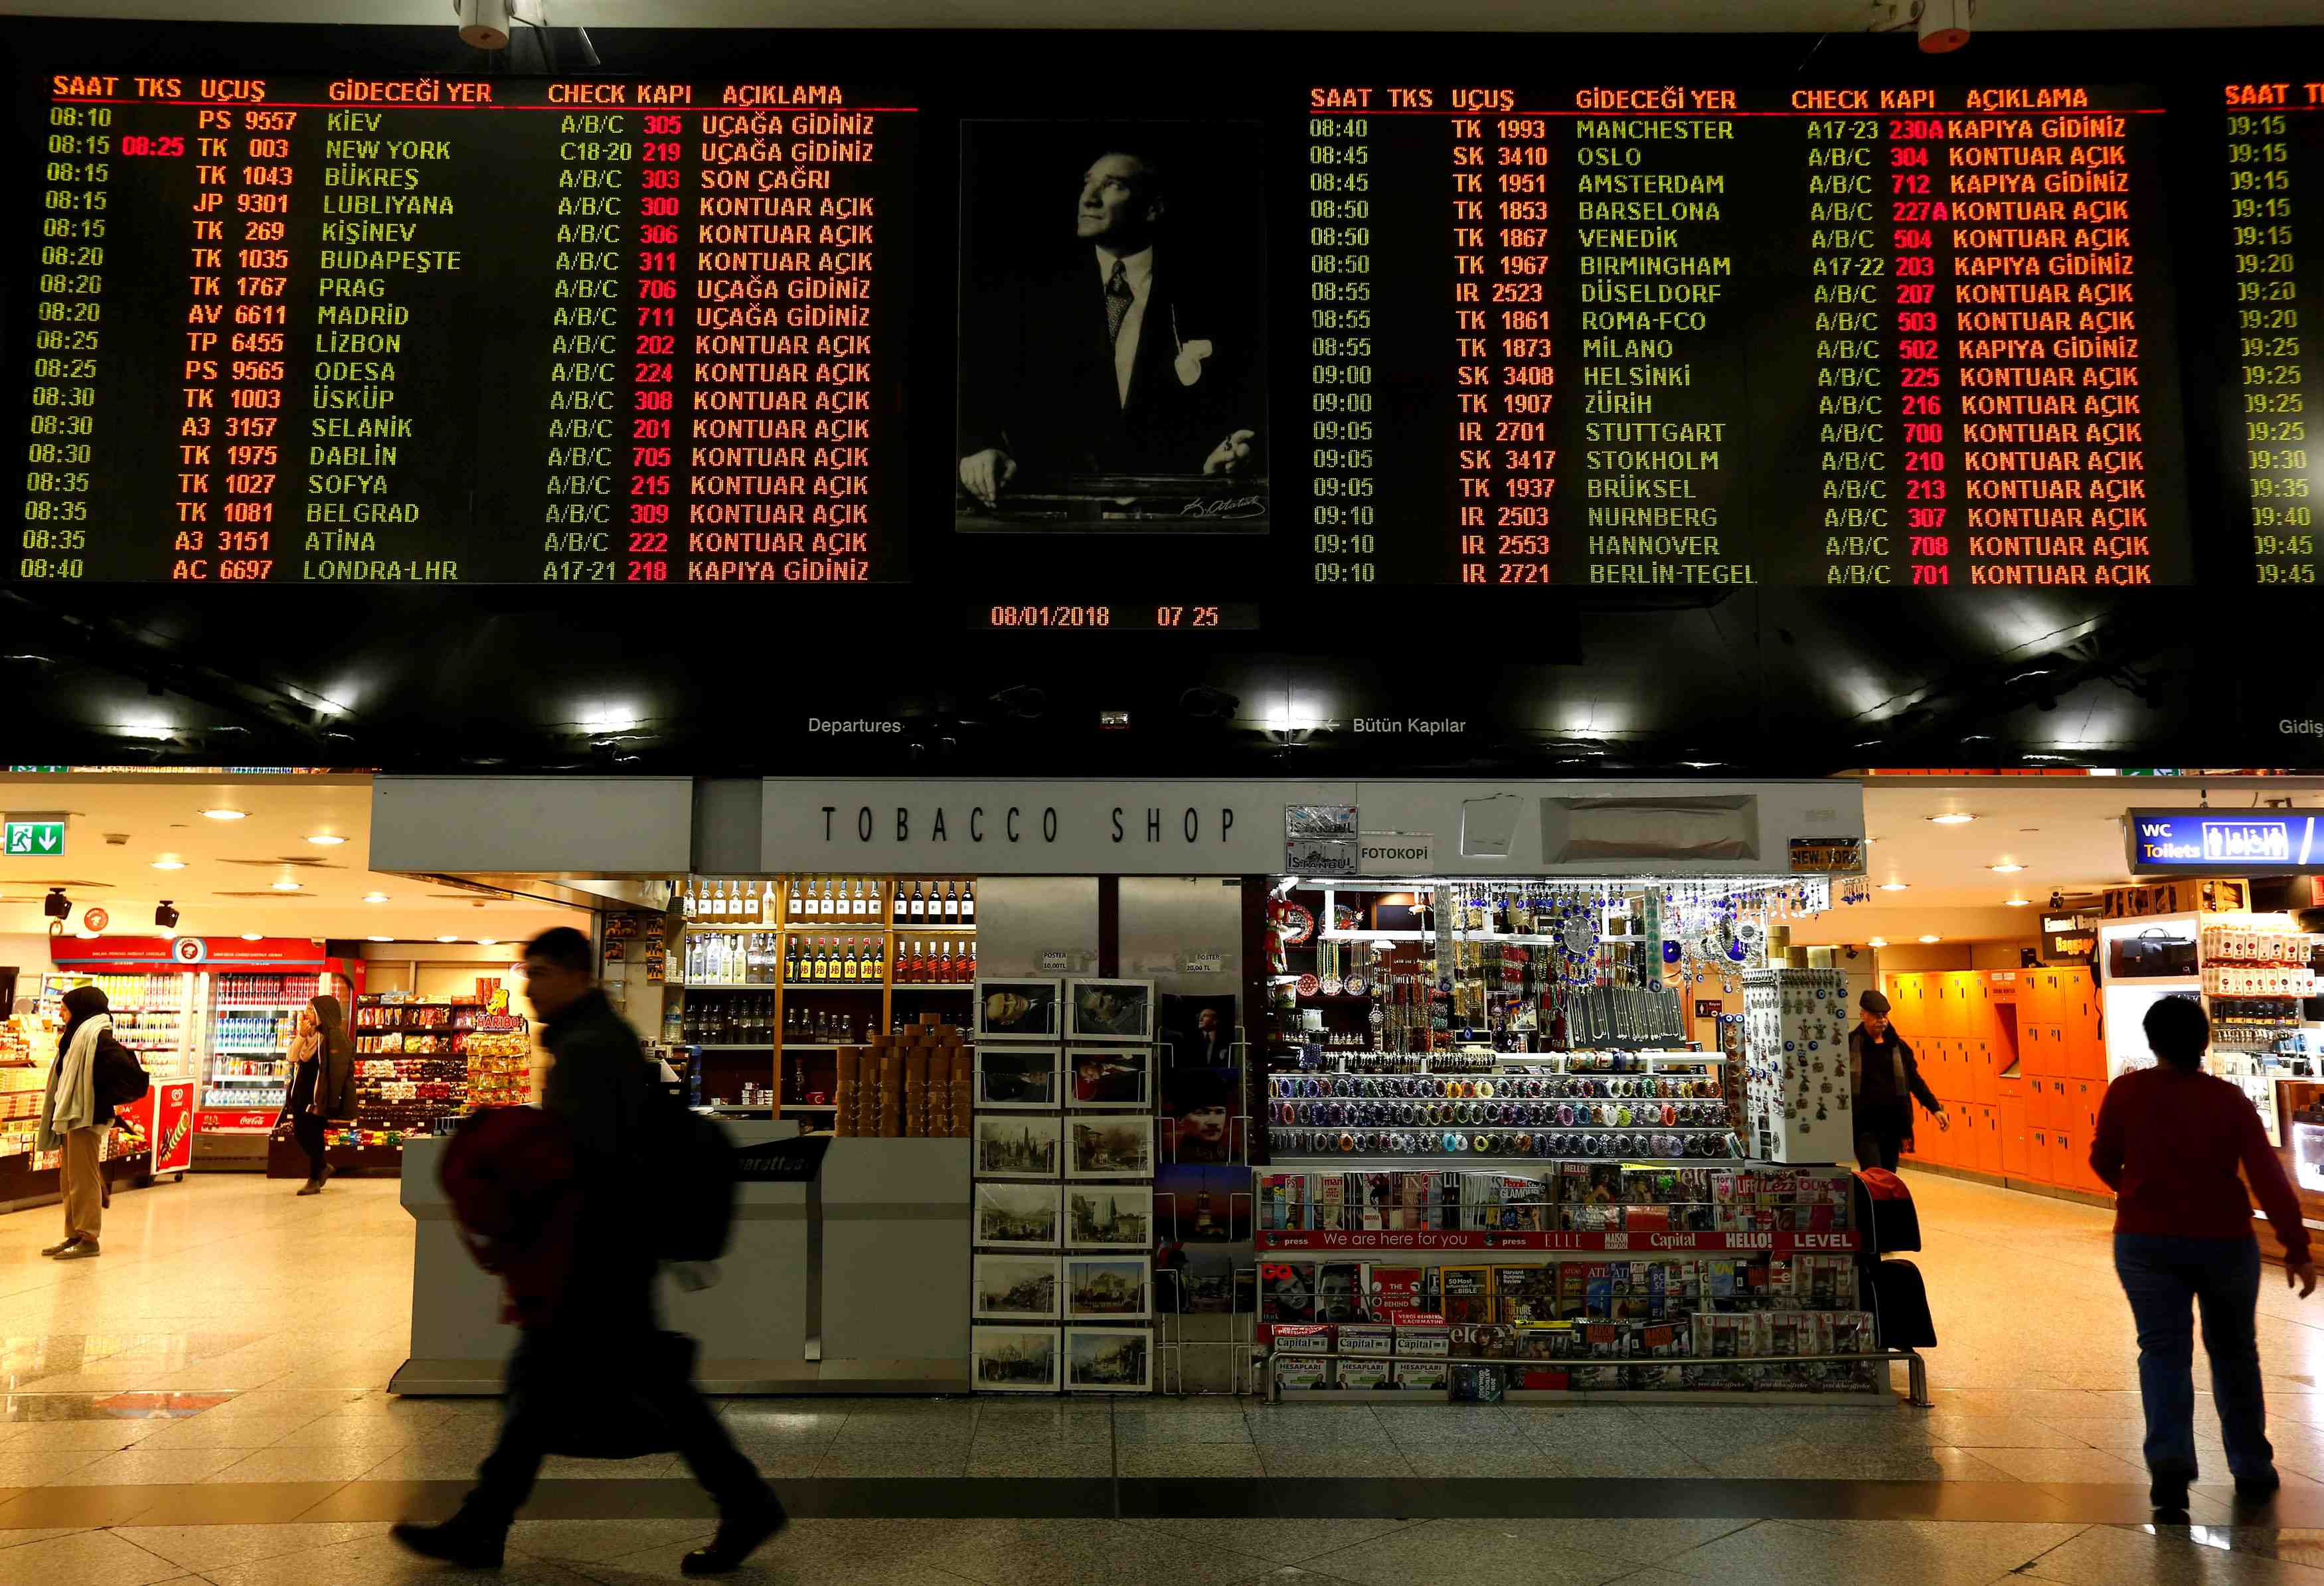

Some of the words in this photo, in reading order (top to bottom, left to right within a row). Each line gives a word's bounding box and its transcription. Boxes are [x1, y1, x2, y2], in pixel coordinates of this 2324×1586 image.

[54, 76, 119, 96] SAAT
[134, 78, 181, 97] TKS
[201, 80, 266, 102] UÇUŞ
[329, 78, 439, 104] GİDECEĞİ
[446, 82, 492, 102] YER
[548, 84, 625, 103] CHECK
[637, 85, 691, 104] KAPI
[723, 85, 842, 106] AÇIKLAMA
[1311, 88, 1372, 107] SAAT
[1387, 89, 1432, 108] TKS
[1452, 89, 1514, 112] UÇUŞ
[1576, 86, 1685, 109] GİDECEĞİ
[1691, 90, 1736, 108] YER
[1792, 90, 1868, 109] CHECK
[1880, 90, 1935, 109] KAPI
[1967, 88, 2088, 111] AÇIKLAMA
[2226, 84, 2289, 104] SAAT
[1311, 119, 1367, 137] 08:40
[1452, 119, 1481, 138] TK
[1498, 120, 1545, 138] 1993
[1578, 121, 1734, 139] MANCHESTER
[1808, 121, 1878, 138] A17-23
[1890, 119, 1944, 139] 230A
[1948, 120, 2033, 139] KAPIYA
[2041, 115, 2125, 138] GİDİNİZ
[49, 135, 110, 154] 08:15
[122, 135, 185, 157] 08:25
[197, 138, 228, 157] TK
[250, 138, 290, 157] 003
[327, 141, 382, 159] NEW
[387, 141, 450, 159] YORK
[561, 143, 631, 160] C18-20
[643, 142, 681, 161] 219
[702, 138, 782, 165] UÇAĞA
[791, 140, 872, 161] GİDİNİZ
[48, 163, 108, 181] 08:15
[197, 165, 226, 185] TK
[243, 166, 293, 185] 1043
[326, 163, 419, 190] BÜKREŞ
[560, 170, 622, 187] A/B/C
[642, 169, 680, 189] 303
[701, 170, 749, 189] SON
[758, 165, 829, 192] ÇAĞRI
[1313, 366, 1370, 384] 09:00
[1459, 366, 1489, 384] SK
[1504, 366, 1554, 385] 3408
[1585, 364, 1689, 386] HELSİNKİ
[1819, 368, 1880, 386] A/B/C
[1902, 368, 1940, 387] 225
[1961, 367, 2075, 386] KONTUAR
[2082, 367, 2138, 389] AÇIK
[31, 416, 92, 434] 08:30
[182, 418, 210, 436] A3
[225, 418, 278, 437] 3157
[312, 416, 412, 437] SELANİK
[550, 420, 612, 437] A/B/C
[633, 419, 670, 438] 201
[693, 420, 807, 438] KONTUAR
[815, 420, 869, 441] AÇIK
[21, 559, 83, 578] 08:40
[173, 560, 207, 579] AC
[220, 560, 272, 579] 6697
[304, 561, 457, 580] LONDRA-LHR
[544, 562, 614, 580] A17-21
[627, 561, 667, 581] 218
[689, 562, 774, 580] KAPIYA
[784, 558, 869, 581] GİDİNİZ
[1315, 564, 1374, 582] 09:10
[1463, 564, 1486, 584] IR
[1500, 564, 1549, 584] 2721
[1591, 562, 1756, 583] BERLİN-TEGEL
[1827, 566, 1890, 584] A/B/C
[1911, 565, 1949, 584] 701
[1971, 565, 2088, 584] KONTUAR
[2095, 565, 2151, 586] AÇIK
[991, 607, 1109, 626] 08/01/2018
[1157, 607, 1183, 626] 07
[1193, 607, 1218, 626] 25
[809, 718, 901, 735] Departures
[1353, 718, 1403, 733] Bütün
[1407, 718, 1465, 736] Kapılar
[822, 806, 1057, 843] TOBACCO
[1112, 807, 1234, 843] SHOP
[2142, 823, 2173, 838] WC
[1361, 846, 1428, 860] FOTOKOPİ
[2143, 842, 2201, 858] Toilets
[1288, 852, 1354, 869] İSTANBUL
[2056, 937, 2094, 955] Baggage
[477, 1016, 519, 1028] HARIBO
[1564, 1164, 1589, 1173] HELLO!
[1323, 1233, 1347, 1245] We
[1352, 1235, 1375, 1245] are
[1380, 1233, 1413, 1245] here
[1418, 1233, 1437, 1245] for
[1440, 1235, 1467, 1247] you
[1545, 1233, 1582, 1248] ELLE
[1605, 1233, 1629, 1242] MAISON
[1650, 1233, 1697, 1249] Capital
[1725, 1233, 1774, 1249] HELLO!
[1794, 1233, 1853, 1248] LEVEL
[1263, 1265, 1292, 1280] GQ
[1504, 1307, 1532, 1316] CULTURE
[1277, 1337, 1311, 1348] Capital
[1340, 1337, 1374, 1349] Capital
[1398, 1338, 1432, 1349] Capital
